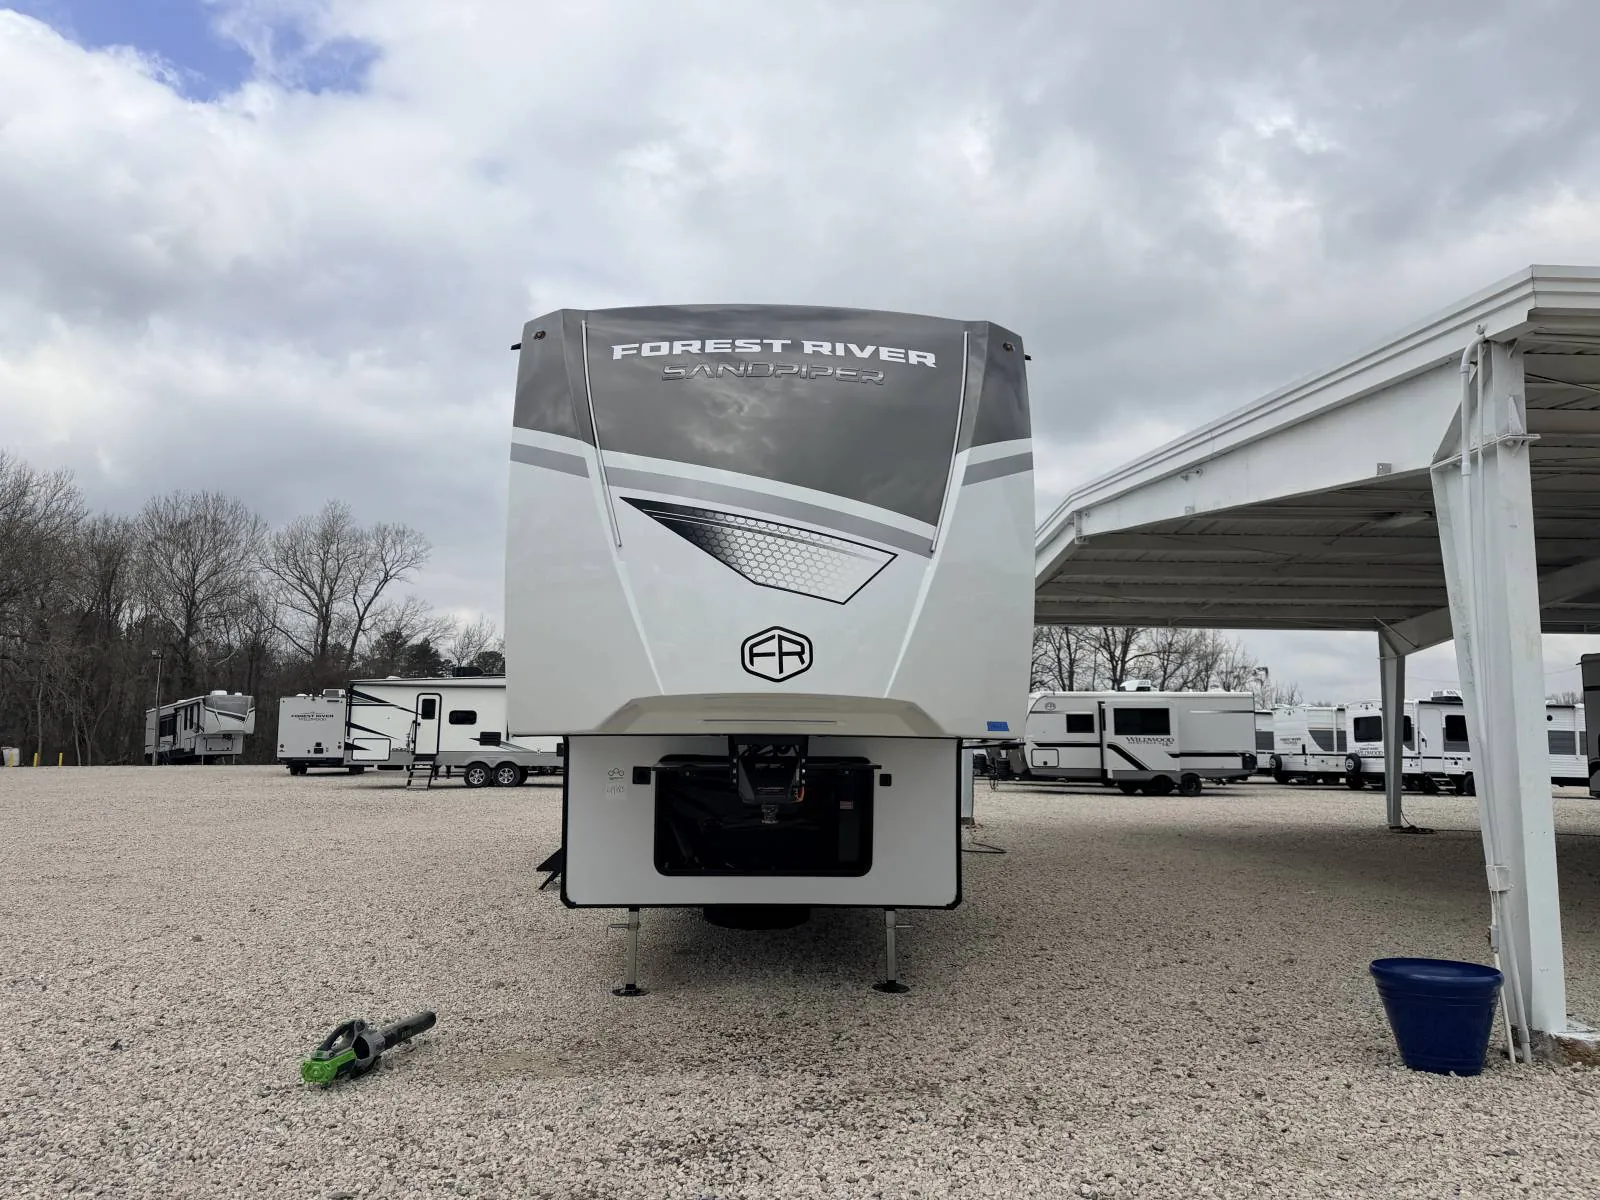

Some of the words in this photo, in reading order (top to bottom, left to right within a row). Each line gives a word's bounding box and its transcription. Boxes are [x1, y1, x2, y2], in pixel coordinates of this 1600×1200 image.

[611, 339, 792, 360] FOREST
[800, 340, 937, 368] RIVER
[661, 361, 885, 385] SANDPIPER
